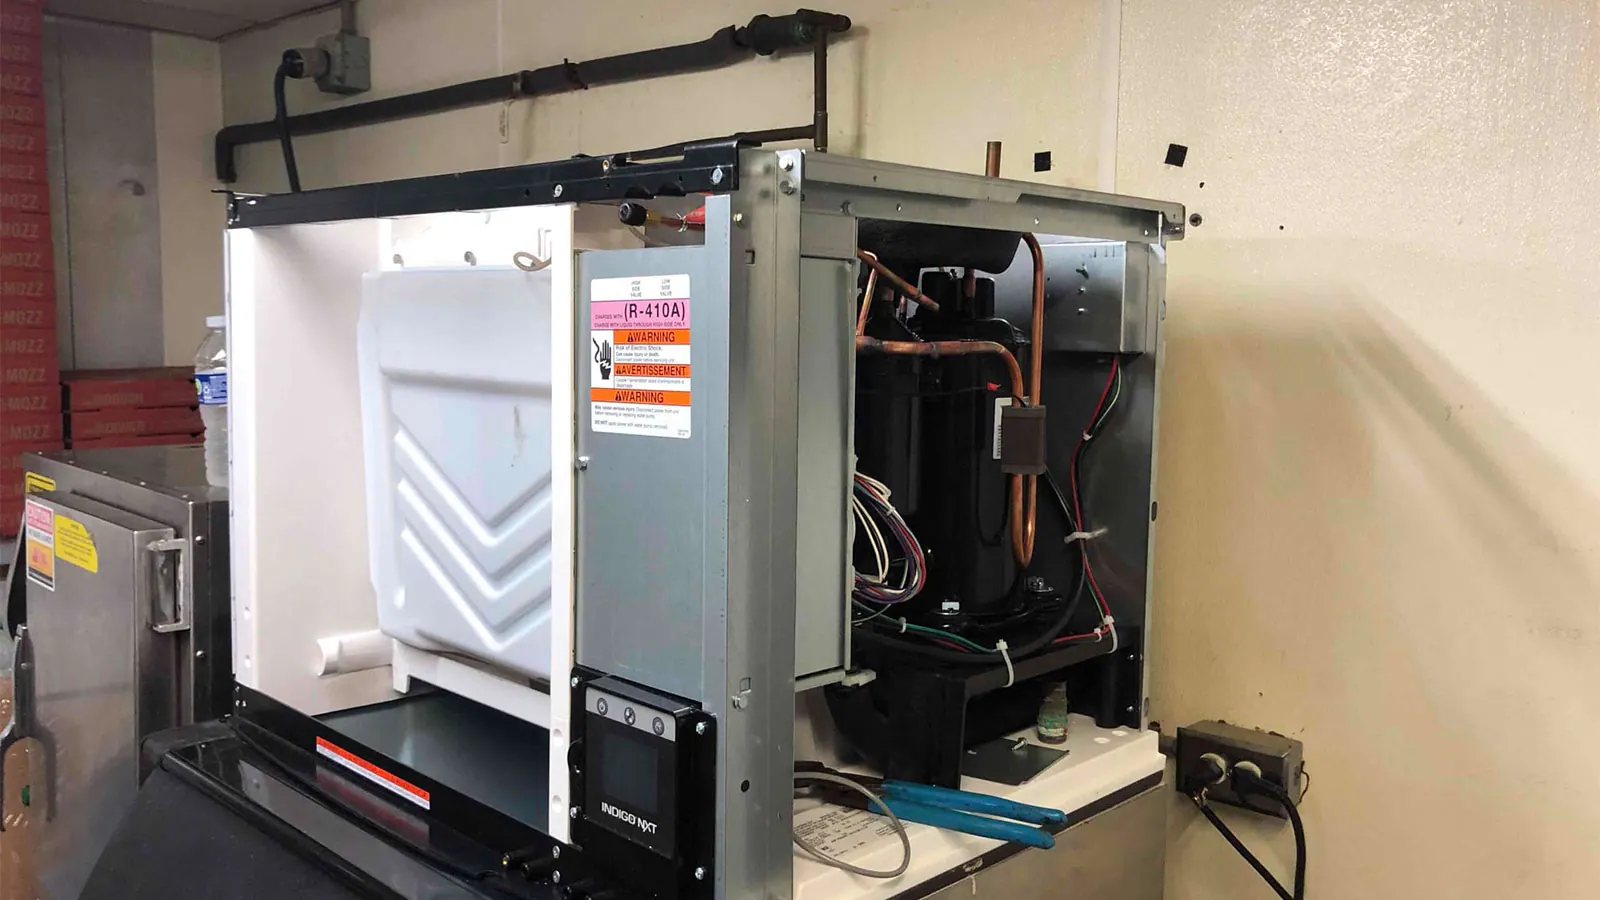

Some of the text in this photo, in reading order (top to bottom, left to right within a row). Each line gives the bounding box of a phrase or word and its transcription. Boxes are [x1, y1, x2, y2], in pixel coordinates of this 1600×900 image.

[624, 301, 686, 322] (R-410A)
[633, 331, 675, 343] WARNING
[622, 365, 686, 377] AVERTISSEMENT
[621, 390, 664, 404] WARNING
[601, 801, 658, 835] INDIGO NXT
